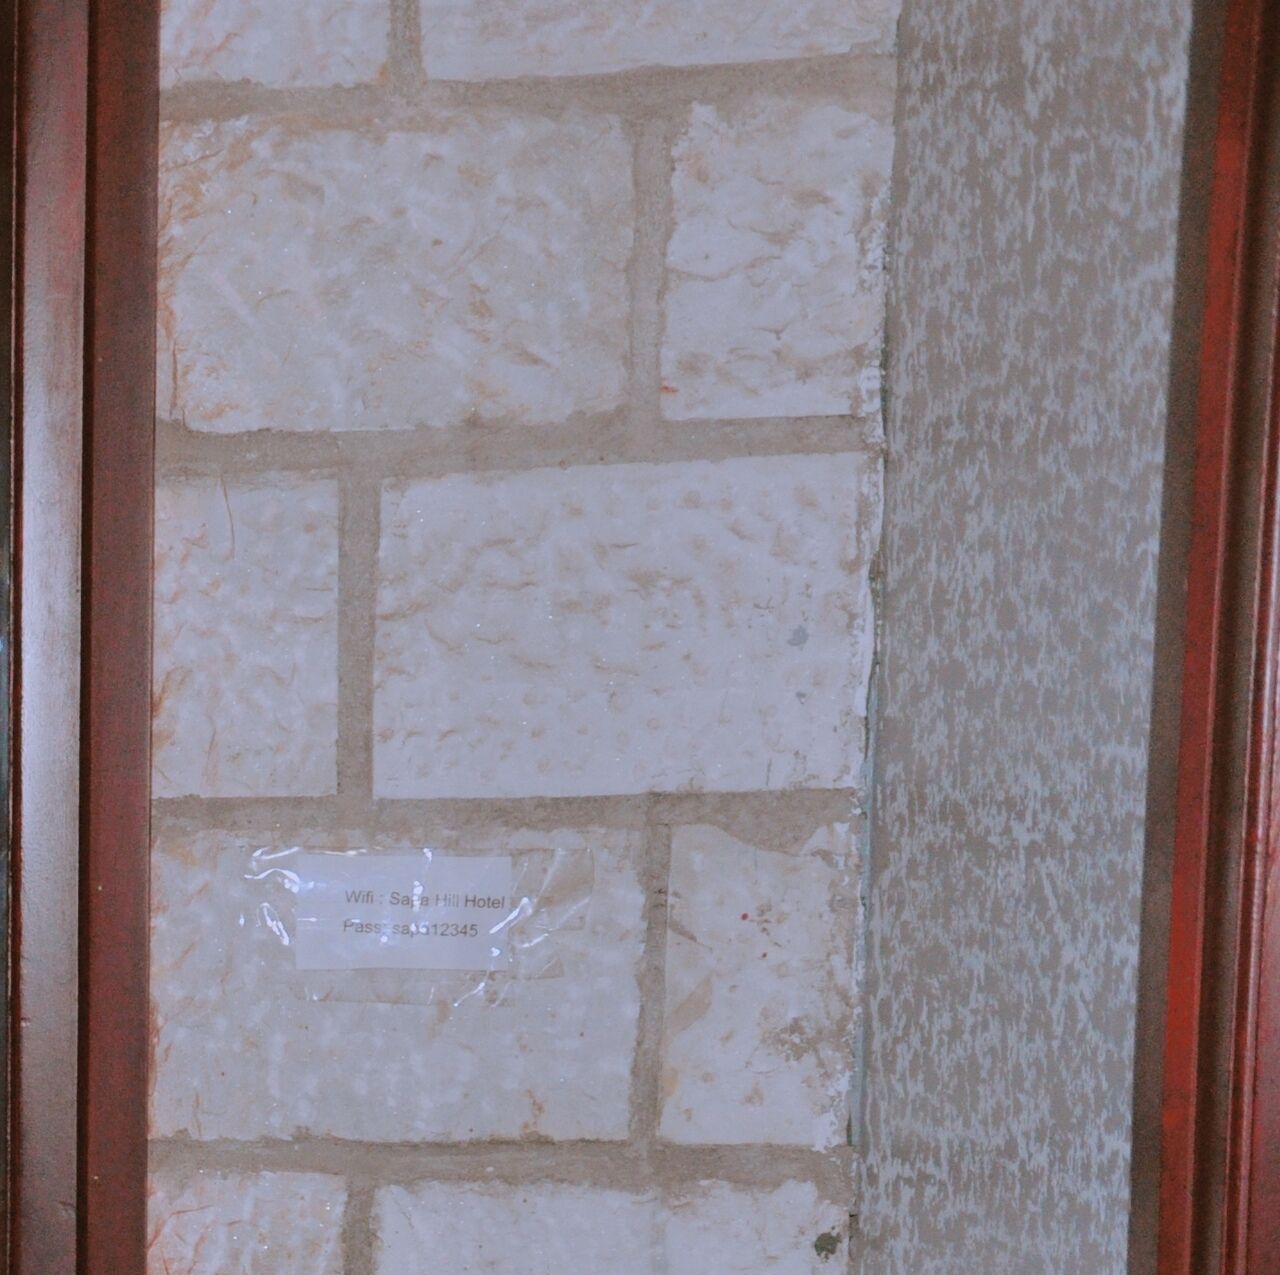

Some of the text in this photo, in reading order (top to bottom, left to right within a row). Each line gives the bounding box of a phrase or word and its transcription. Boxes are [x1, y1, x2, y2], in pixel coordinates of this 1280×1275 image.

[344, 889, 375, 905] Wifi
[434, 893, 460, 908] Hill
[463, 894, 506, 910] Hotel
